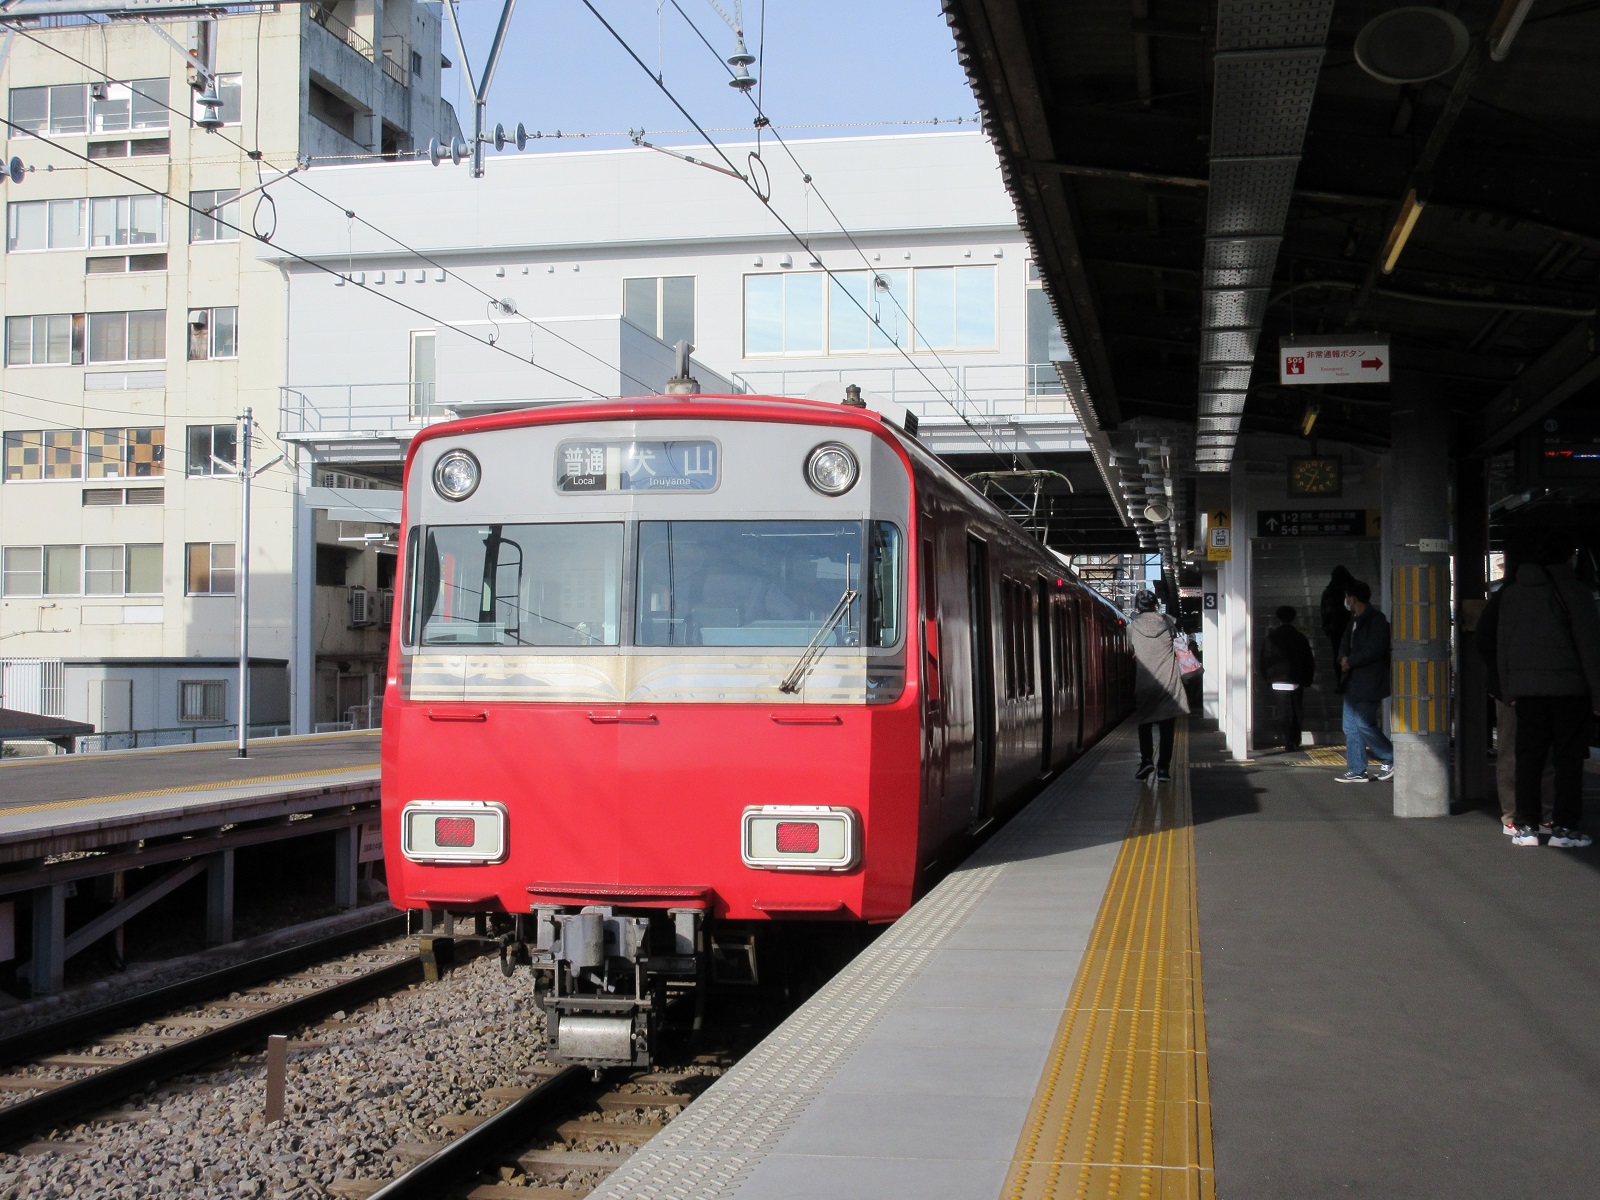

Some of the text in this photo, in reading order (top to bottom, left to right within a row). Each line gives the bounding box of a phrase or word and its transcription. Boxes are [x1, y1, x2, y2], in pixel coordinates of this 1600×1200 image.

[1306, 350, 1366, 359] 非常通報ボタン
[564, 447, 604, 477] 普通
[573, 477, 596, 485] Local
[649, 477, 691, 487] Inuyama
[1206, 595, 1215, 608] 3
